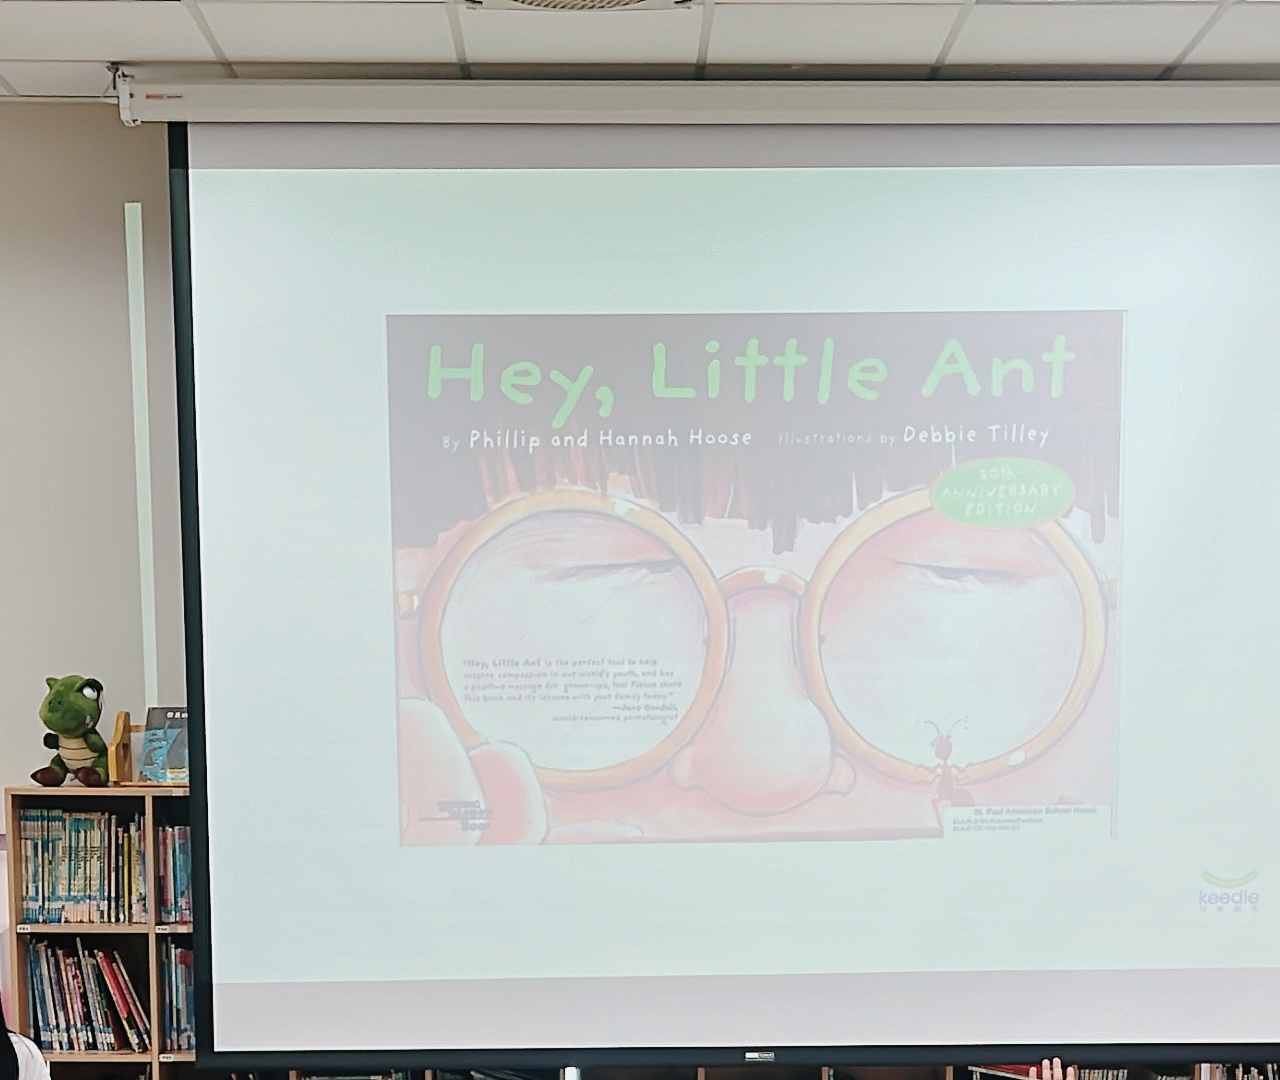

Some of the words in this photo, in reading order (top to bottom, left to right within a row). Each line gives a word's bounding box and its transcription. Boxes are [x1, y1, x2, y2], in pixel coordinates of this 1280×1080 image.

[427, 343, 615, 428] Hey,
[652, 337, 888, 404] Little
[921, 334, 1077, 400] Ant
[442, 434, 461, 453] By
[469, 429, 540, 454] Phillip
[551, 428, 588, 448] and
[599, 428, 679, 448] Hannah
[688, 427, 754, 447] Hoose
[778, 433, 873, 447] Illustrations
[880, 434, 896, 449] by
[902, 424, 977, 444] Debbie
[988, 422, 1050, 449] Tilley
[939, 482, 1062, 500] ANNIVERSARY
[965, 501, 1038, 516] EDITION
